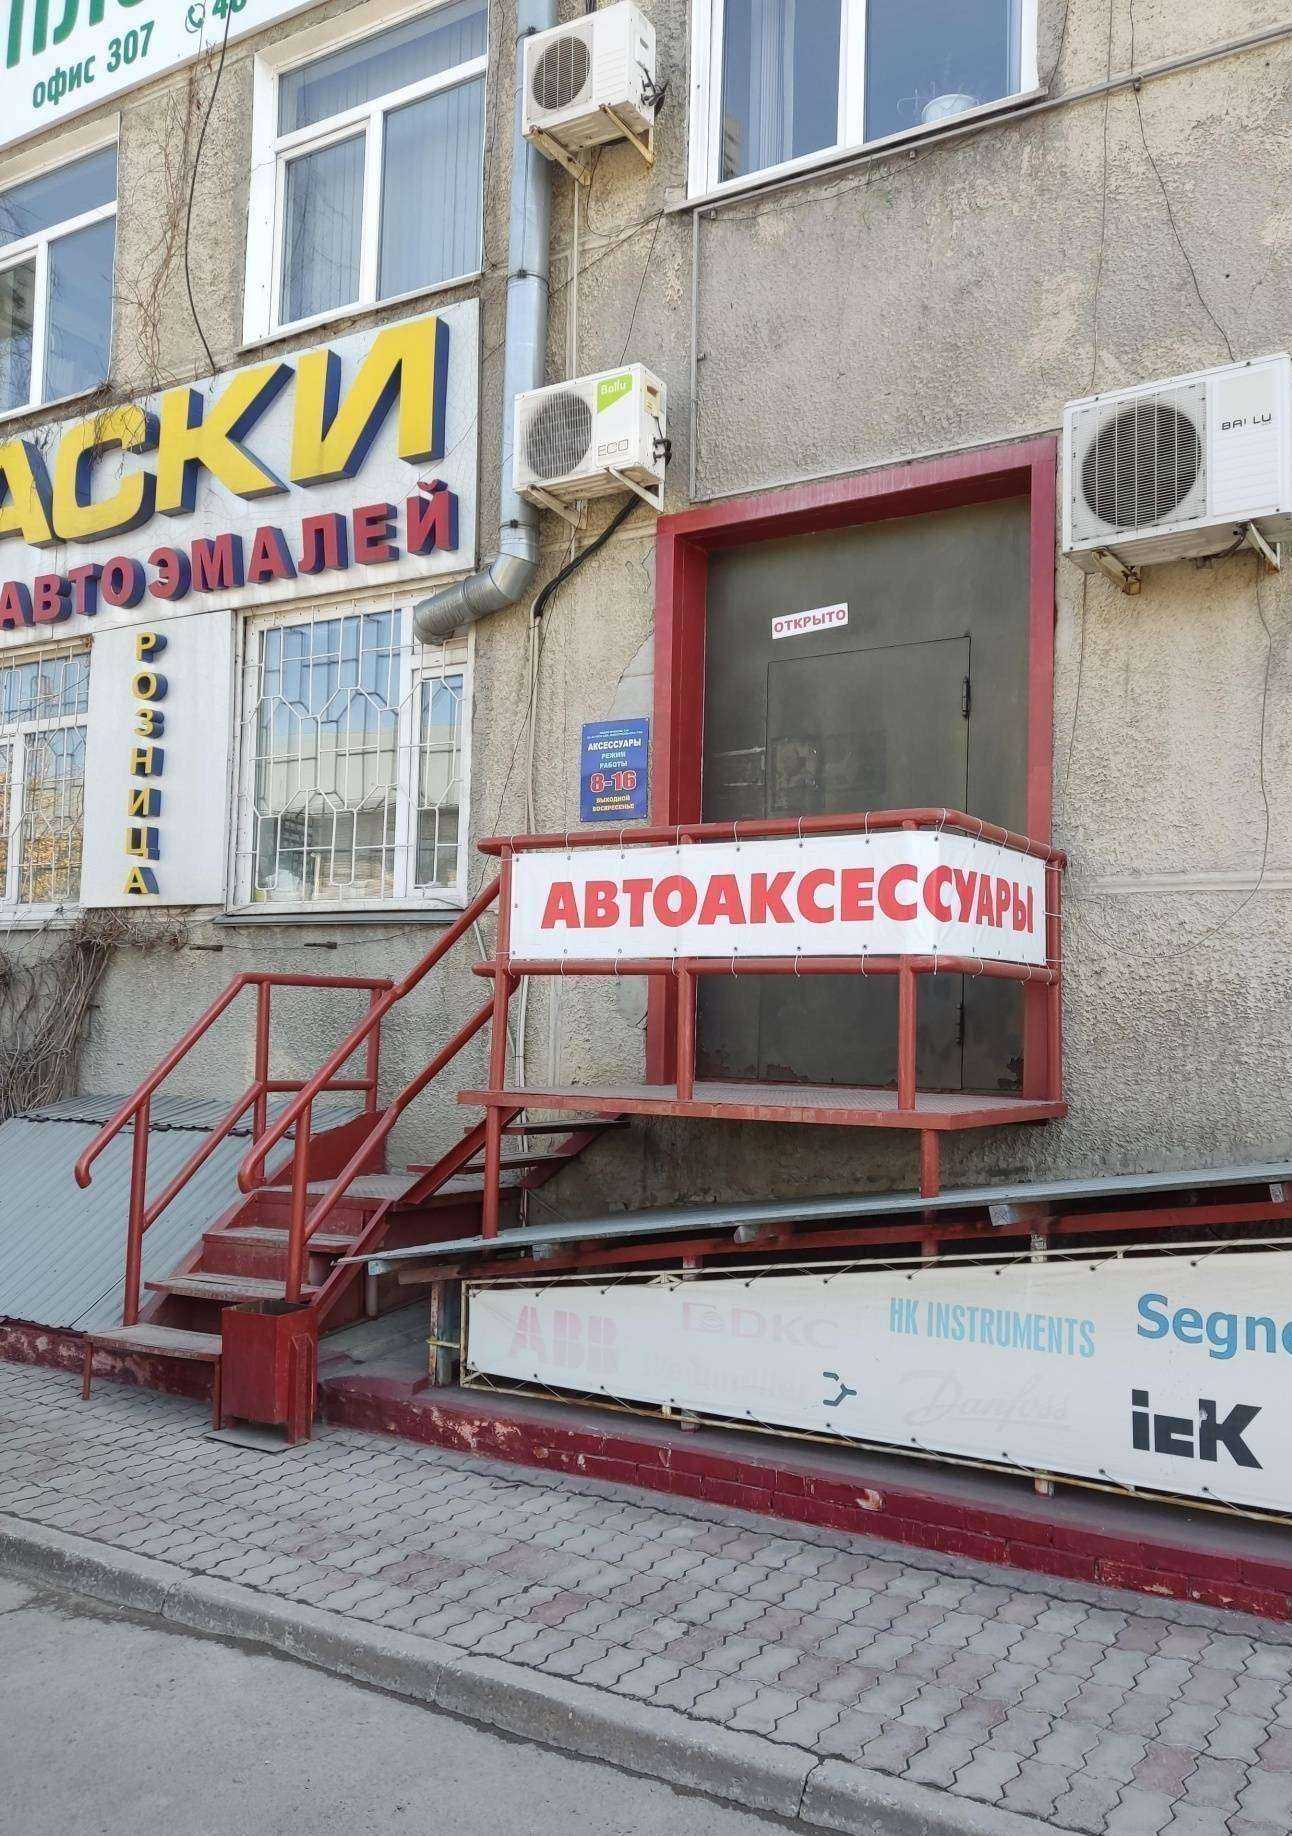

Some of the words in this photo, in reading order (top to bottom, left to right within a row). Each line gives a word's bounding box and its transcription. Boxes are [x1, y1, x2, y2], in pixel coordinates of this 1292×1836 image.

[32, 55, 96, 108] офис
[106, 20, 155, 73] 307
[597, 438, 629, 457] ECO
[0, 479, 459, 630] АВТОЭМАЛЕЙ
[773, 608, 847, 634] ОТКРЫТО
[587, 738, 642, 752] АКСЕССУАРЫ
[601, 751, 627, 760] РЕЖИМ
[123, 631, 168, 894] РОЗНИЦА
[600, 761, 628, 769] РАБОТЫ
[590, 770, 637, 793] 8-16
[595, 794, 631, 804] ВЫХОДНОЙ
[540, 863, 1035, 934] АВТОАКСЕССУАРЫ
[889, 1297, 920, 1335] HK
[926, 1301, 1096, 1358] INSTRUMENTS
